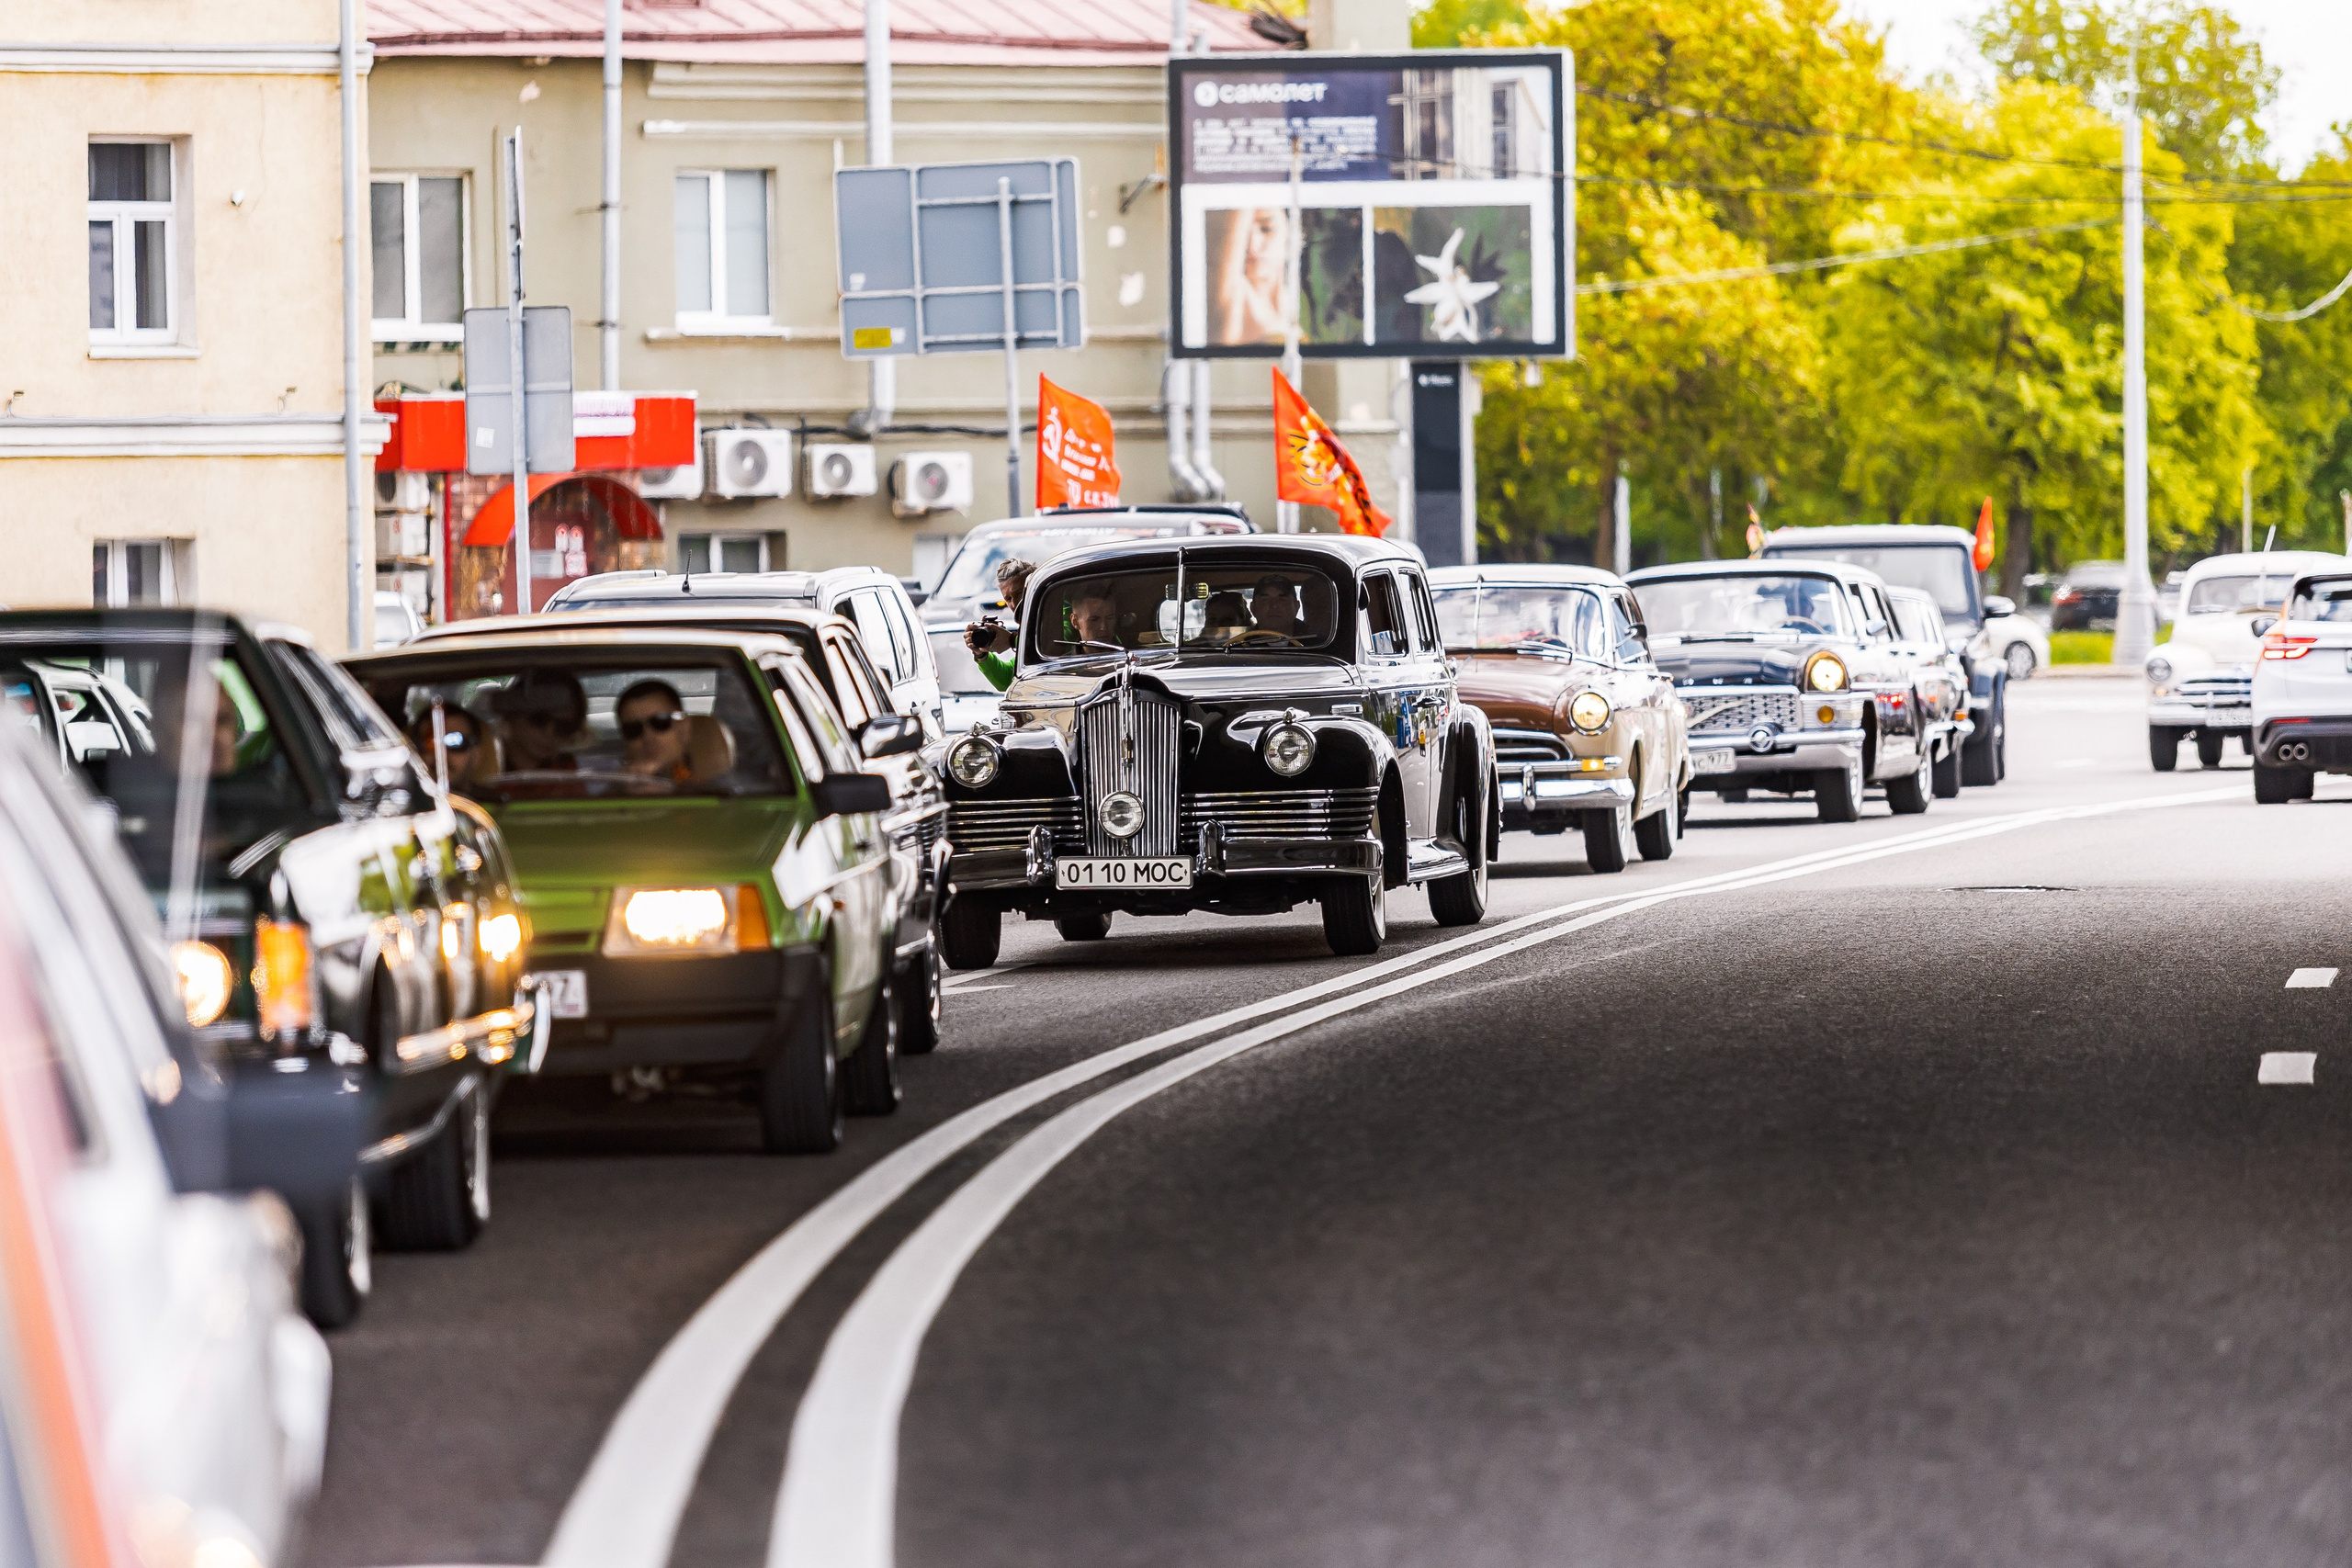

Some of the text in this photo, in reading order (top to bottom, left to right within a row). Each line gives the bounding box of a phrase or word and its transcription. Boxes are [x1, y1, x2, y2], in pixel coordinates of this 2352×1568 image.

[1068, 862, 1184, 883] 01 10 МОС
